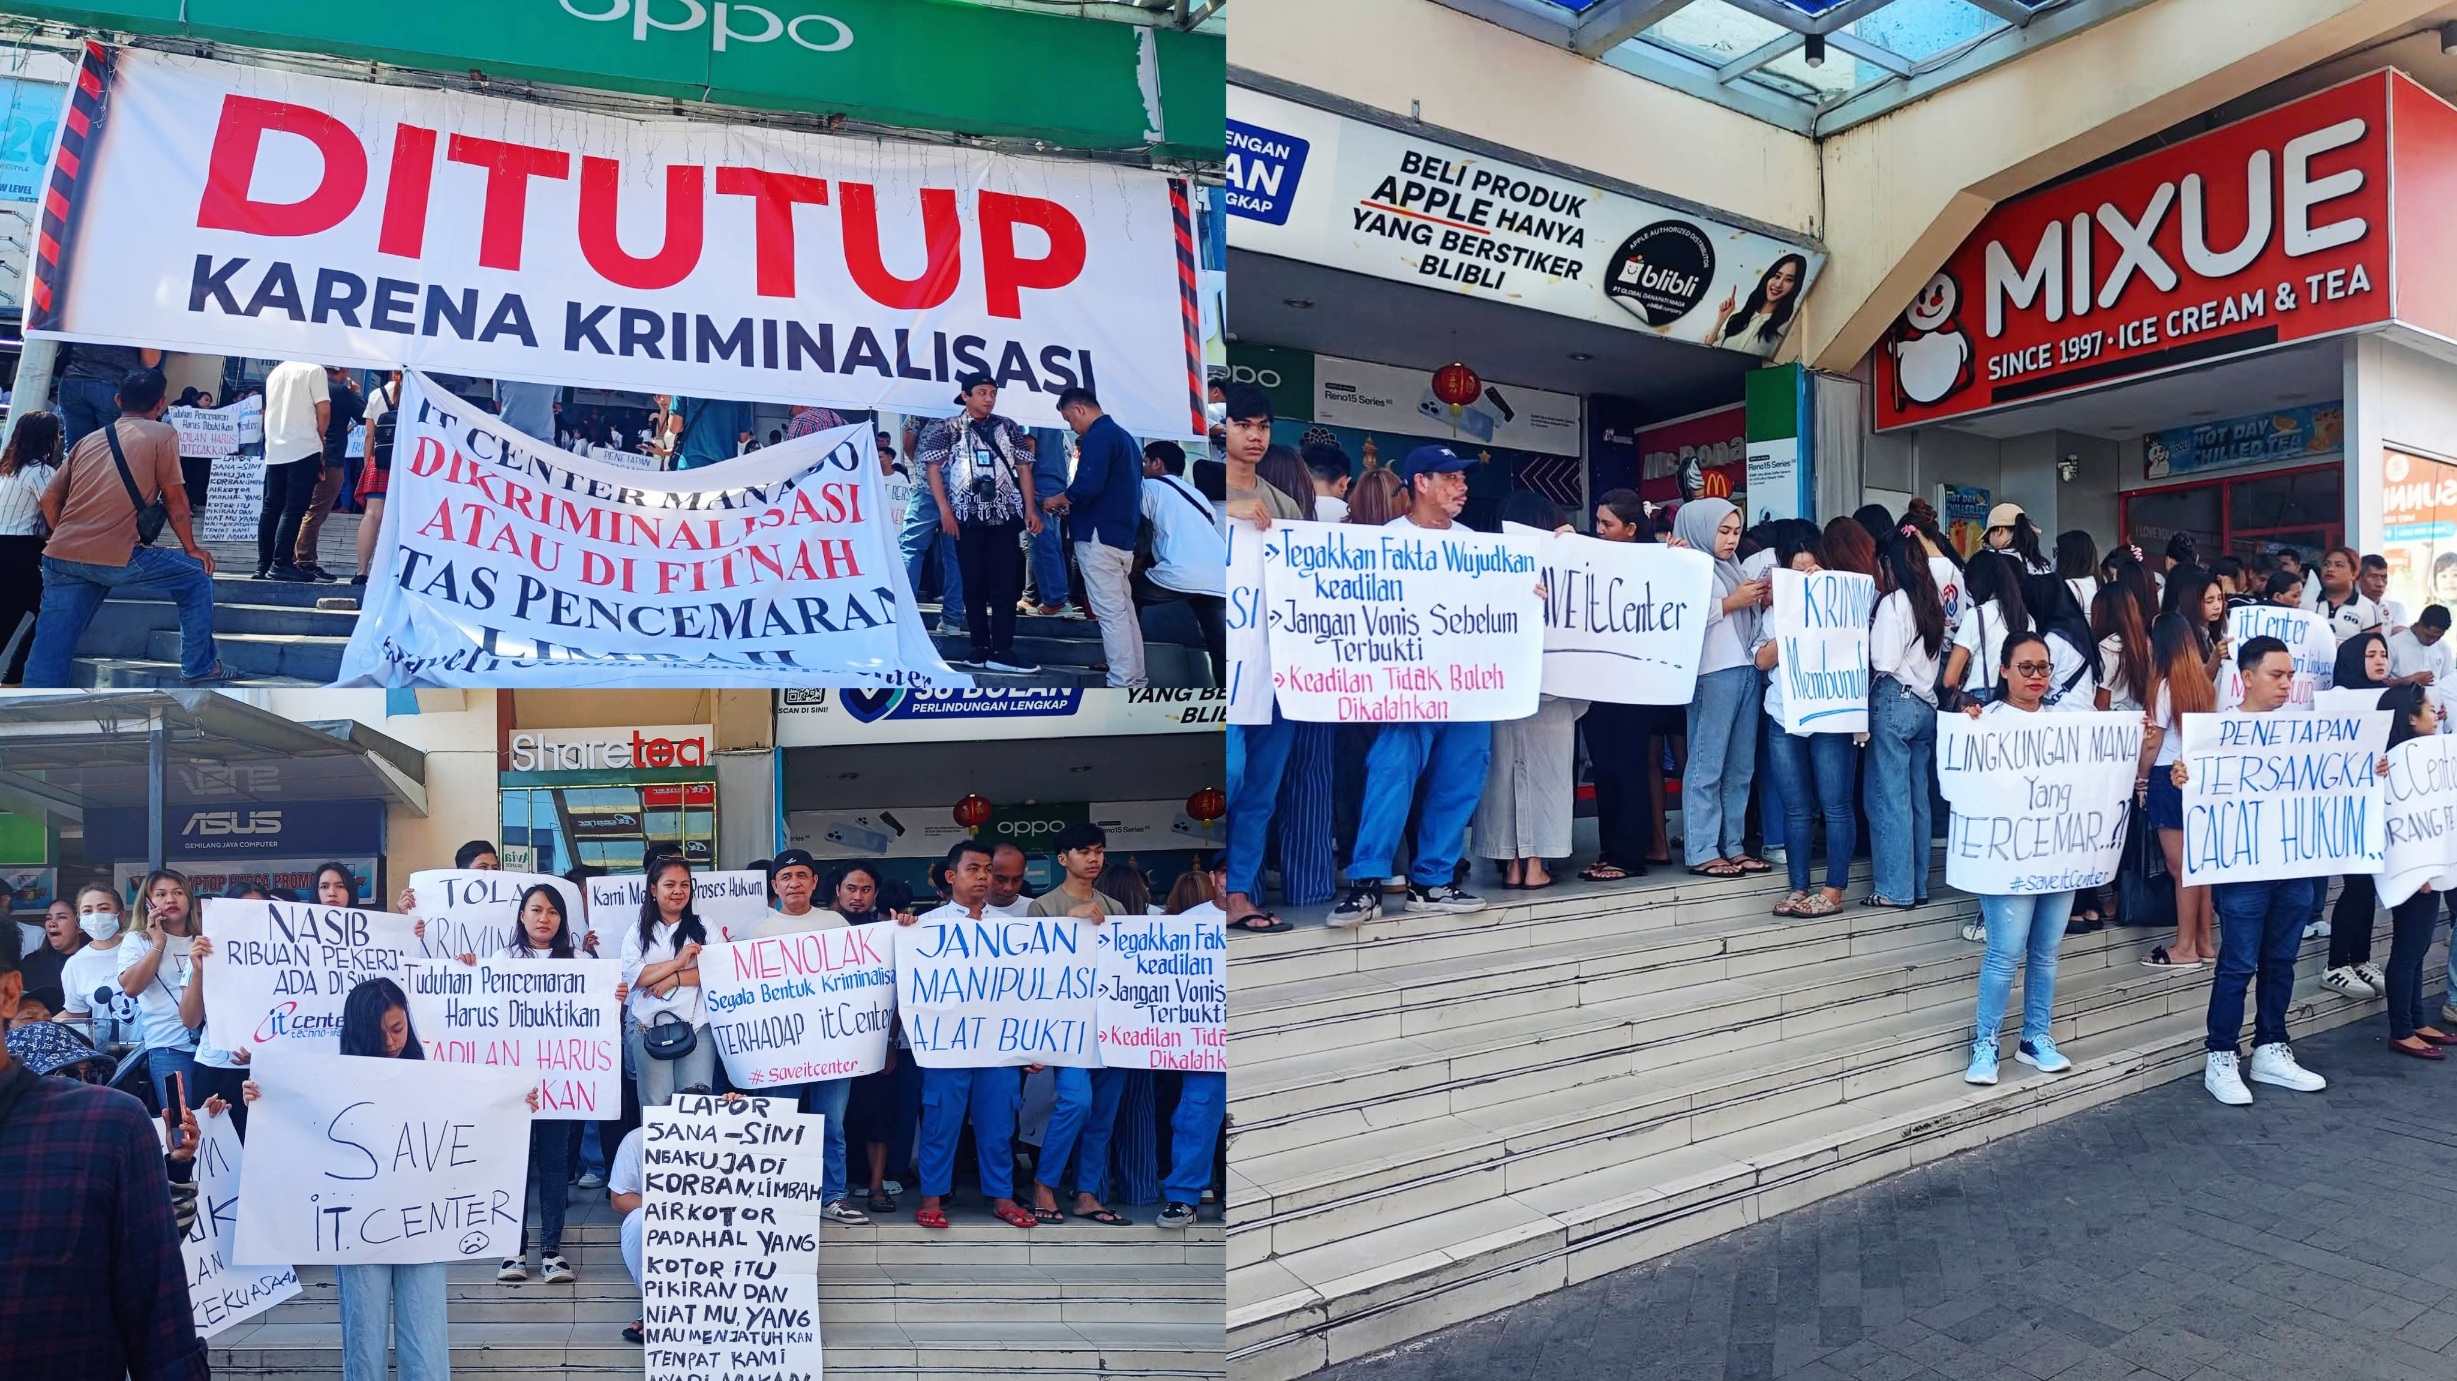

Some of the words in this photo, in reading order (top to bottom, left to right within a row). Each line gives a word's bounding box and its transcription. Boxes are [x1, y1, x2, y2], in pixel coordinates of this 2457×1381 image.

[559, 0, 854, 52] oppo
[1400, 150, 1468, 186] BELI
[1471, 169, 1587, 219] PRODUK
[197, 94, 1087, 319] DITUTUP
[1370, 175, 1493, 227] APPLE
[1495, 208, 1585, 248] HANYA
[1353, 207, 1433, 246] YANG
[1440, 230, 1583, 280] BERSTIKER
[1629, 232, 1650, 250] APPLE
[1649, 225, 1692, 237] AUTHORIZED
[1985, 117, 2367, 339] MIXUE
[1418, 253, 1506, 290] BLIBLI
[1641, 265, 1700, 298] blibli
[188, 254, 539, 348] KARENA
[564, 301, 1096, 398] KRIMINALISASI
[1987, 342, 2053, 381] SINCE
[2059, 329, 2103, 365] 1997
[2118, 319, 2158, 351] ICE
[2166, 288, 2265, 339] CREAM
[2274, 281, 2296, 313] &
[2305, 263, 2372, 303] TEA
[417, 396, 458, 430] IT
[466, 428, 647, 507] CENTER
[661, 441, 859, 511] MANAO
[407, 436, 867, 551] DIKRIMINALISASI
[416, 497, 565, 572] ATAU
[577, 549, 640, 594] DI
[654, 538, 866, 596] FITNAH
[1279, 528, 1376, 578] Tegakkan
[1380, 536, 1438, 571] Fakta
[1442, 540, 1535, 580] Wujudkan
[394, 544, 499, 611] TAS
[510, 574, 898, 641] PENCEMARAN
[1315, 572, 1404, 602] keadilan
[1283, 599, 1356, 644] Jangan
[1361, 605, 1420, 638] Vonis
[1429, 603, 1518, 636] Sebelum
[1331, 637, 1424, 664] Terbukti
[1785, 636, 1867, 700] Membunuh
[1128, 688, 1194, 703] YANG
[1289, 665, 1374, 694] Keadilan
[1382, 665, 1443, 693] Tidak
[1450, 662, 1505, 691] Boleh
[912, 701, 1008, 713] PERLINDUNGAN
[1010, 700, 1068, 711] LENGKAP
[1338, 693, 1449, 722] Dikalahkan
[1944, 725, 2080, 773] LINGKUNGAN
[2088, 724, 2138, 763] MANA
[2219, 718, 2362, 747] PENETAPAN
[512, 730, 705, 772] Sharetea
[2193, 751, 2375, 796] TERSANGKA
[2023, 775, 2073, 814] Yang
[181, 810, 282, 835] ASUS
[997, 820, 1066, 837] oppo
[2186, 799, 2264, 874] CACAT
[240, 840, 278, 848] COMPUTER
[188, 874, 227, 892] APTOP
[439, 878, 526, 909] TOLA
[593, 884, 624, 908] Kami
[691, 877, 726, 900] Proses
[728, 876, 763, 897] Hukum
[268, 902, 370, 948] NASIB
[916, 920, 1078, 959] JANGAN
[1111, 921, 1190, 959] Tegakkan
[227, 940, 310, 966] RIBUAN
[732, 927, 882, 982] MENOLAK
[1137, 952, 1214, 976] keadilan
[273, 970, 318, 996] ADA
[404, 963, 472, 996] Tuduhan
[481, 965, 585, 995] Pencemaran
[707, 990, 756, 1014] Segala
[760, 975, 816, 1004] Bentuk
[821, 965, 897, 993] Kriminalisa
[912, 966, 1097, 1004] MANIPULASI
[1108, 975, 1173, 1009] Jangan
[292, 1012, 344, 1029] cente
[445, 998, 499, 1029] Harus
[509, 999, 600, 1029] Dibuktikan
[713, 1012, 806, 1058] TERHADAP
[914, 1013, 987, 1052] ALAT
[998, 1016, 1086, 1055] BUKTI
[1111, 1025, 1182, 1048] Keadilan
[537, 1038, 612, 1072] HARUS
[678, 1095, 771, 1118] LAPOR
[324, 1101, 478, 1180] SAVE
[360, 1189, 518, 1244] CENTER
[687, 1203, 777, 1227] KOTOR
[647, 1228, 748, 1248] PADAHAL
[756, 1230, 816, 1257] YANG
[647, 1256, 724, 1279] KOTOR
[744, 1284, 788, 1304] DAN
[646, 1328, 685, 1344] MAU
[746, 1306, 811, 1331] YANG
